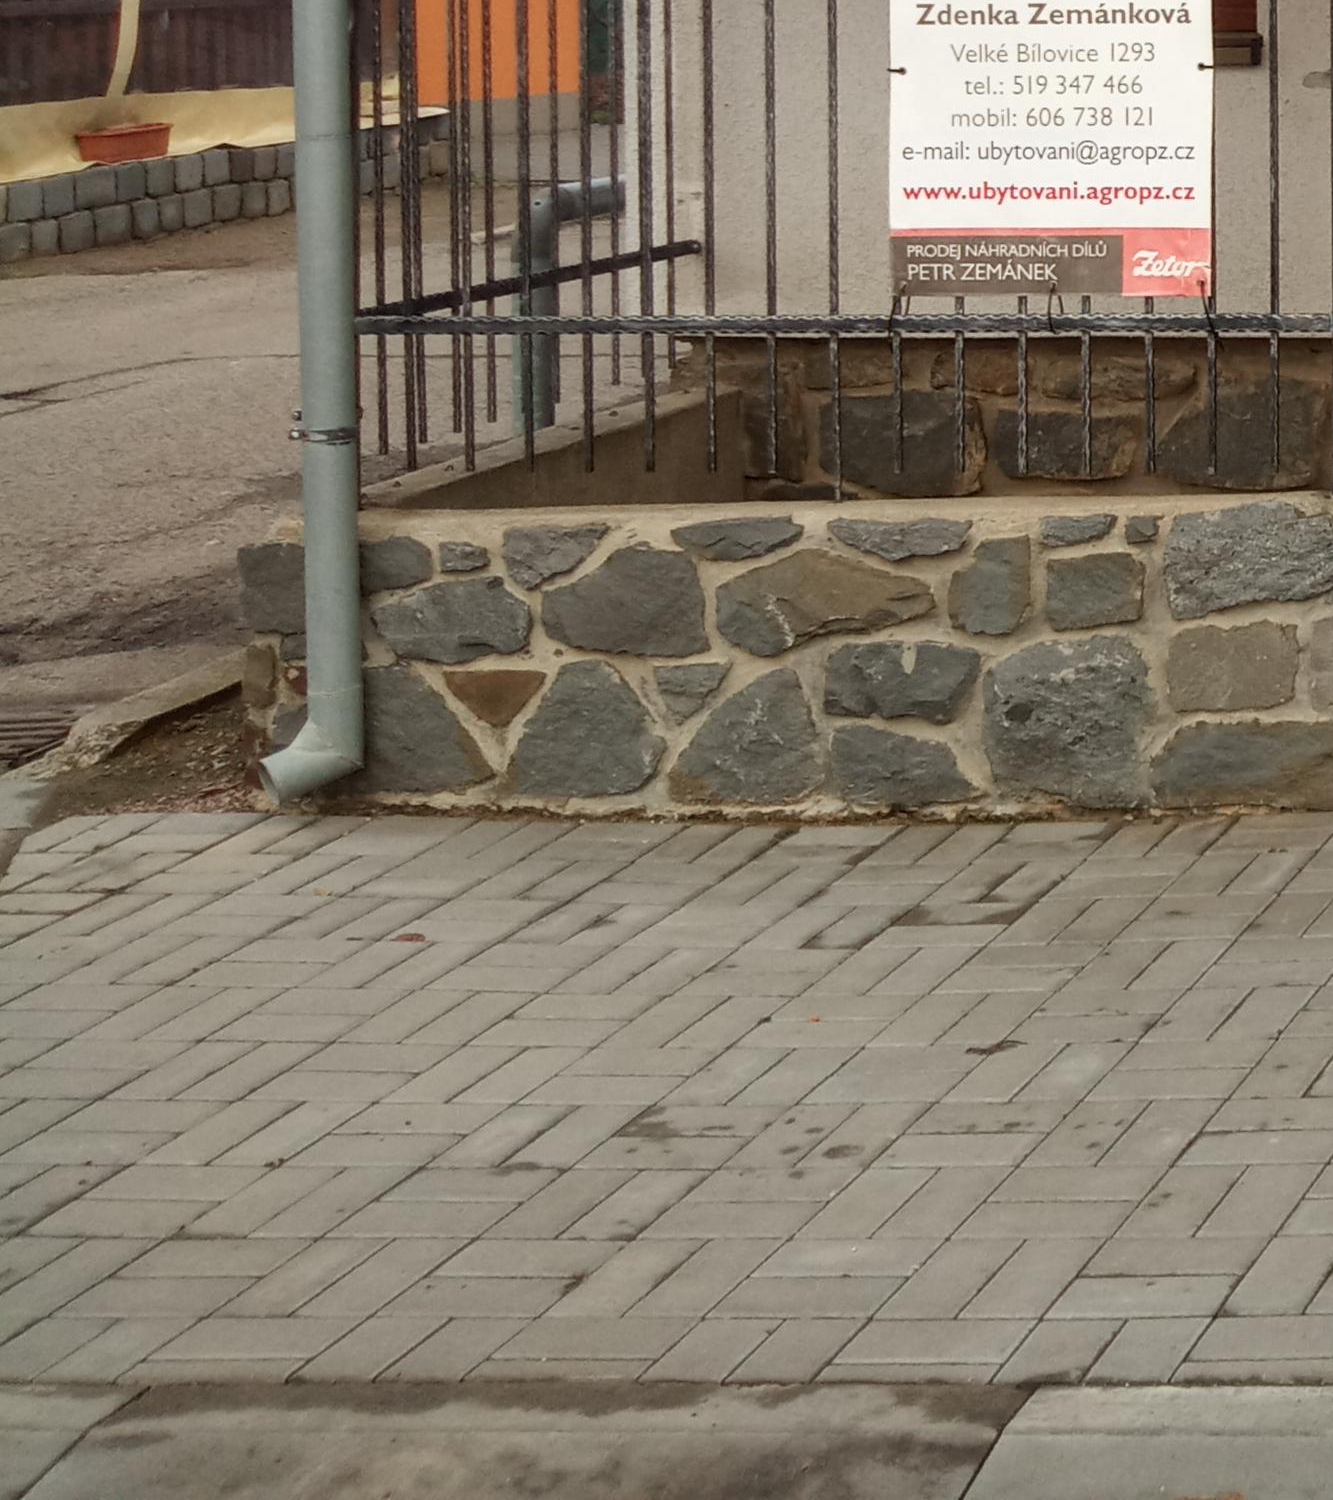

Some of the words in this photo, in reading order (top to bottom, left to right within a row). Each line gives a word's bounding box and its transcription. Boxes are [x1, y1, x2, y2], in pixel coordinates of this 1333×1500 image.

[916, 3, 1020, 26] Zdenka
[1028, 3, 1191, 25] Zemánková
[950, 43, 1009, 63] Velké
[1018, 43, 1099, 63] Bílovice
[1110, 42, 1155, 62] 1293
[965, 76, 1004, 95] tel.:
[1012, 76, 1048, 95] 519
[1056, 75, 1095, 95] 347
[1103, 75, 1143, 94] 466
[951, 108, 1017, 127] mobil:
[1026, 107, 1065, 127] 606
[1074, 107, 1112, 126] 738
[1124, 107, 1153, 126] 121
[902, 142, 970, 160] e-mail:
[978, 140, 1195, 166] ubytovani@agropz.cz
[903, 181, 1195, 205] www.ubytovani.agropz.cz
[906, 244, 961, 260] PRODEJ
[965, 241, 1069, 257] NÁHRADNÍCH
[1072, 240, 1107, 257] DÍLŮ
[907, 263, 956, 281] PETR
[960, 260, 1058, 281] ZEMÁNEK
[1132, 250, 1212, 278] Zetor
